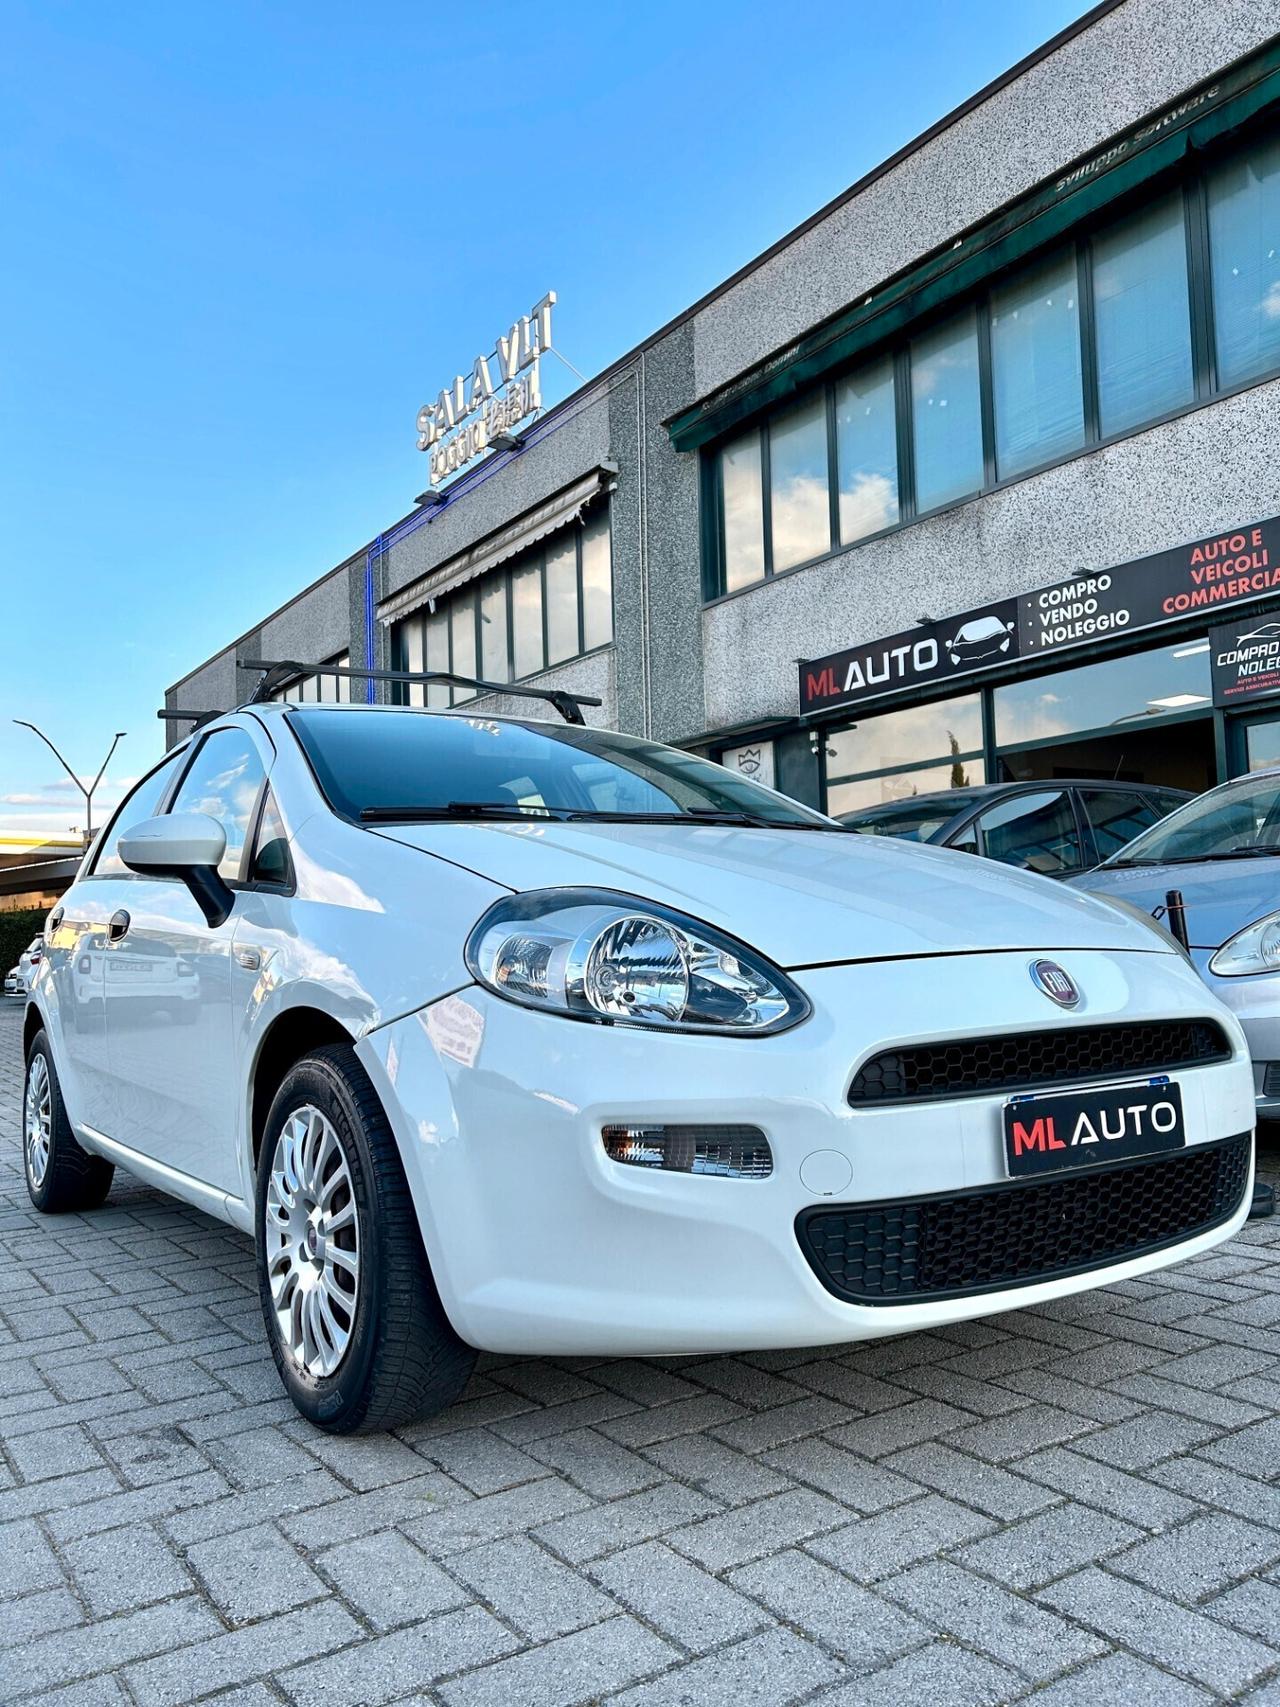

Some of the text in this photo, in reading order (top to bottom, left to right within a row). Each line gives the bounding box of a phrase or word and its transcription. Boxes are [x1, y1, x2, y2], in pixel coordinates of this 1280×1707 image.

[415, 355, 493, 452] SALA
[496, 289, 557, 384] VLT
[1190, 528, 1262, 565] AUTO E
[1190, 549, 1269, 585] VEICOLI
[1038, 574, 1112, 609] COMPRO
[1039, 598, 1098, 627] VENDO
[1040, 609, 1130, 646] NOLEGGIO
[806, 637, 939, 701] ML AUTO
[1217, 641, 1280, 666] COMPRO
[1041, 971, 1073, 993] FIAT
[1012, 1101, 1177, 1156] ML AUTO
